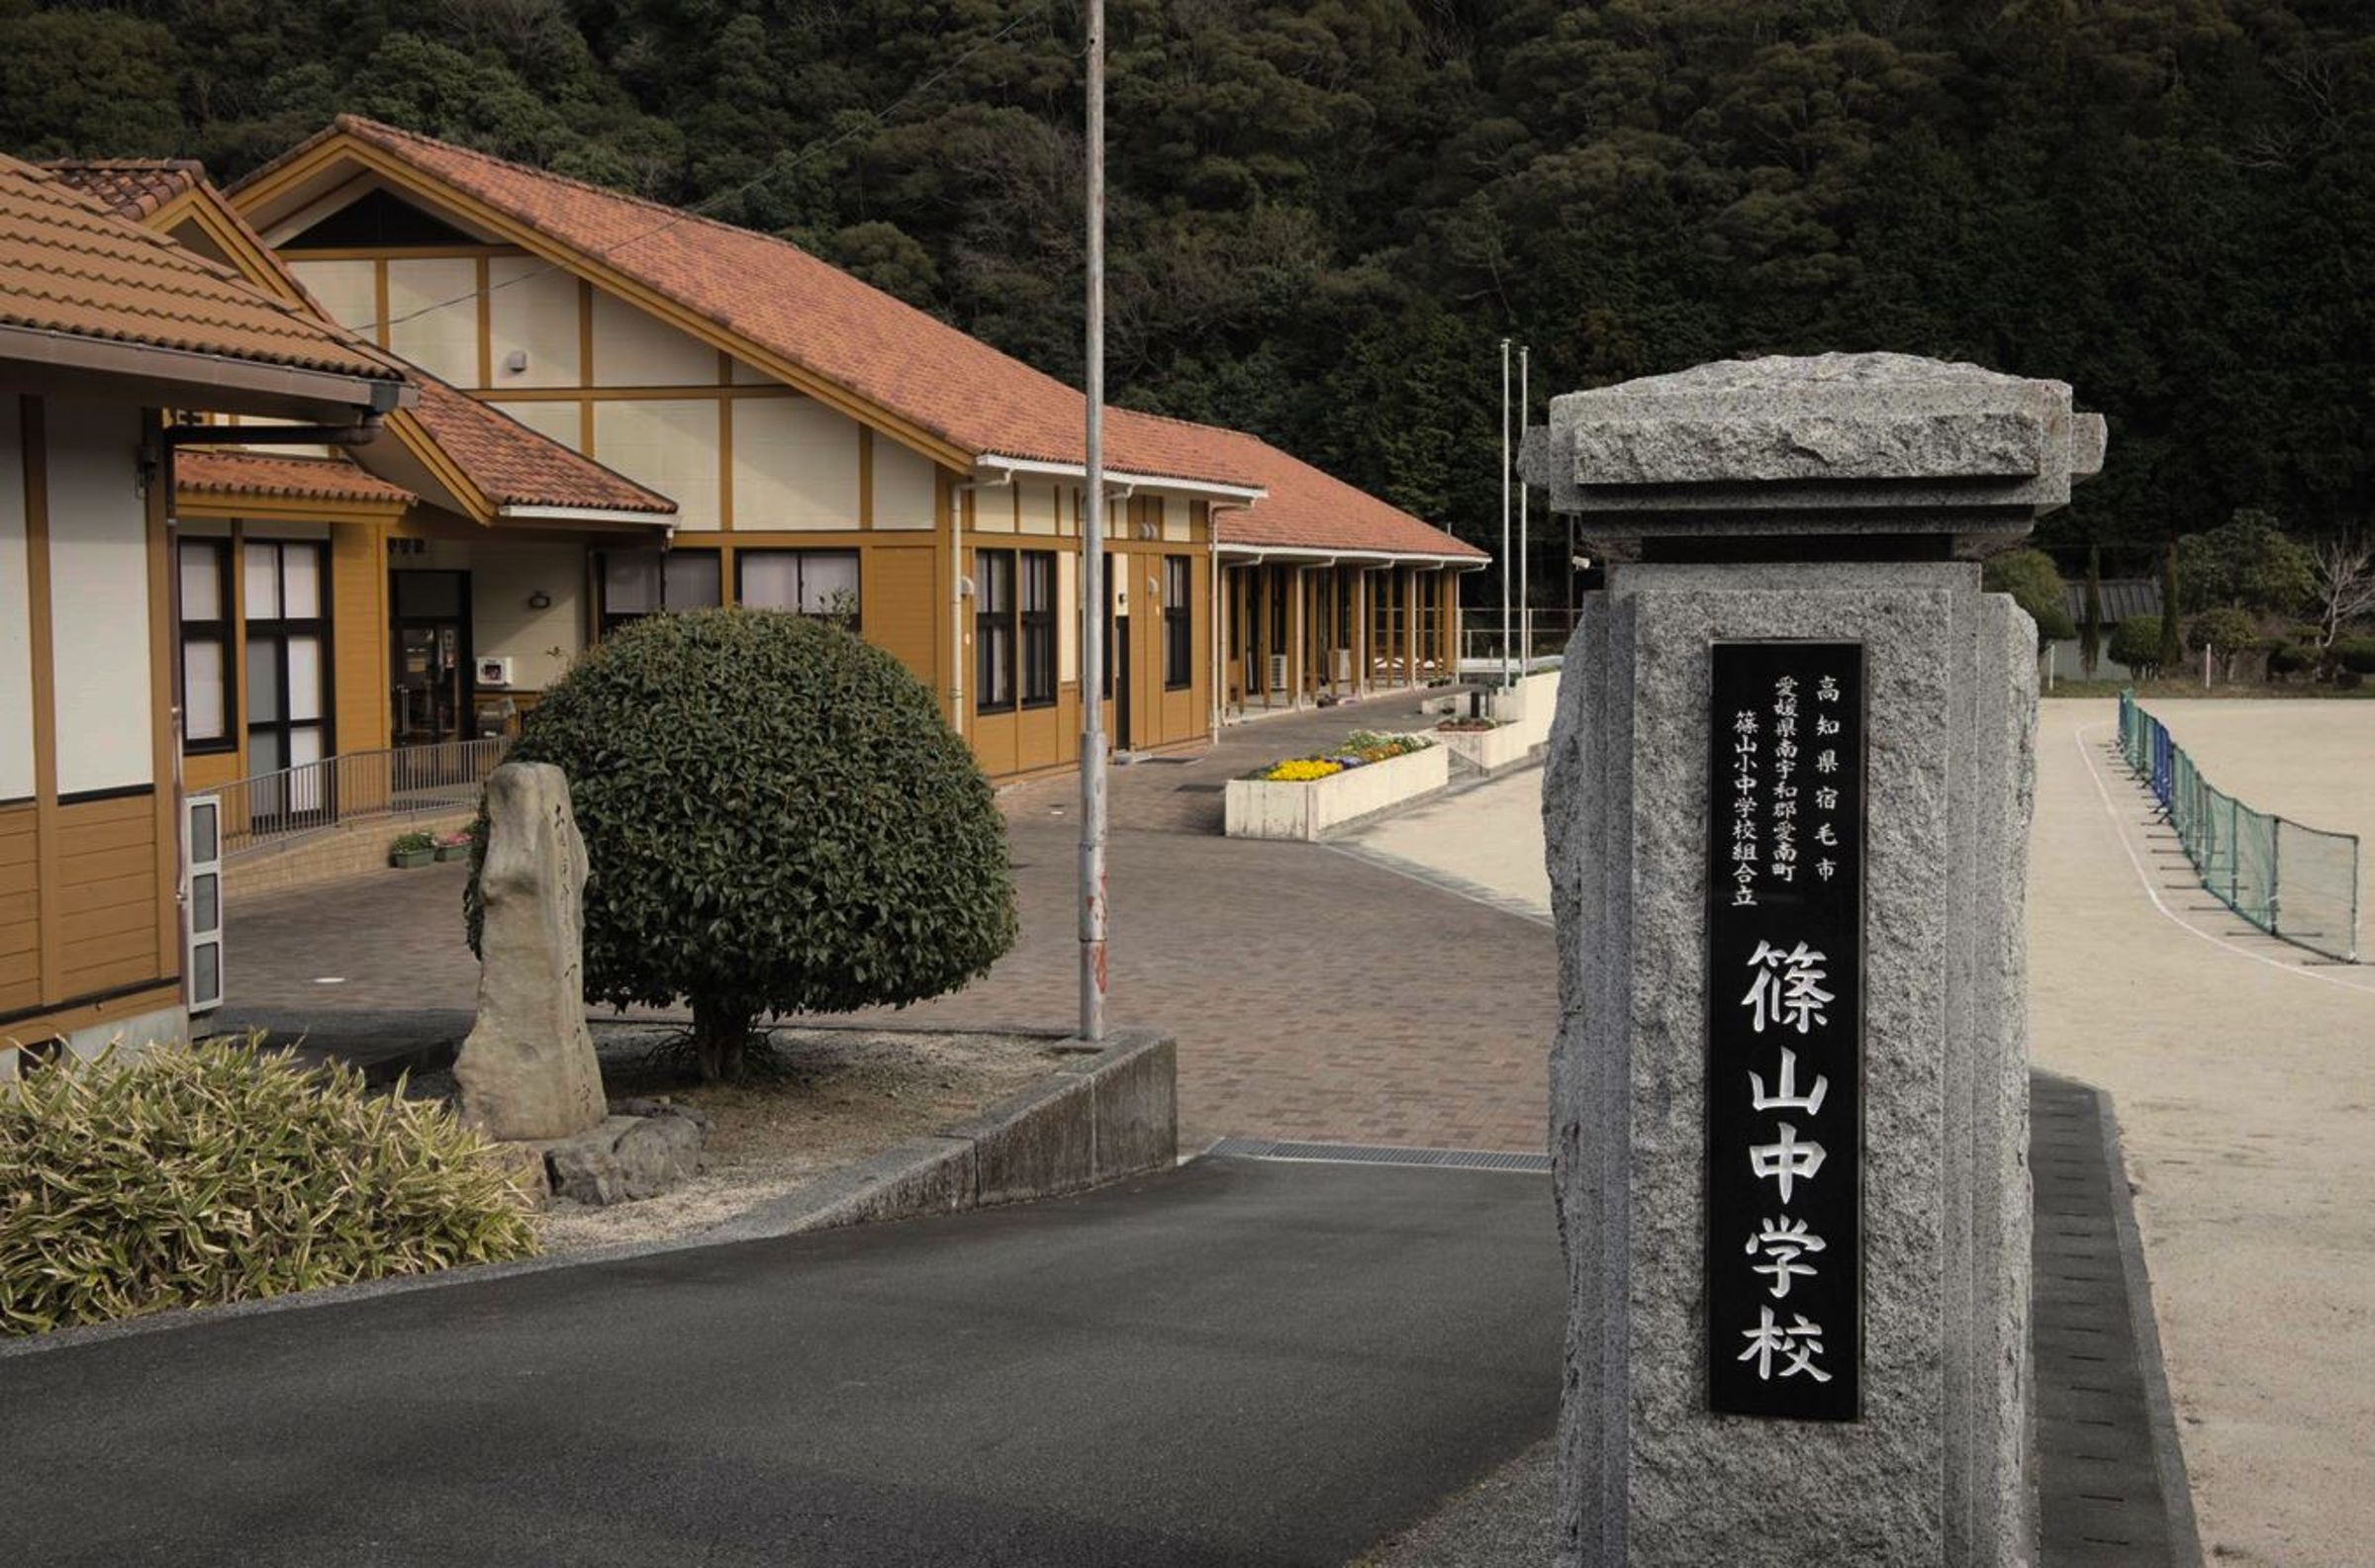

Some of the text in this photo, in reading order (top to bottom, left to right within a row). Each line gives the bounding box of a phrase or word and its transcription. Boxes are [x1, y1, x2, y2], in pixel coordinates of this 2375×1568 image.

[1732, 709, 1758, 906] 篠山小中学校組合立
[1772, 675, 1799, 882] 愛媛県南宇和郡愛南町
[1815, 676, 1841, 882] 高知県宿毛市
[1738, 939, 1836, 1383] 篠山中学校
